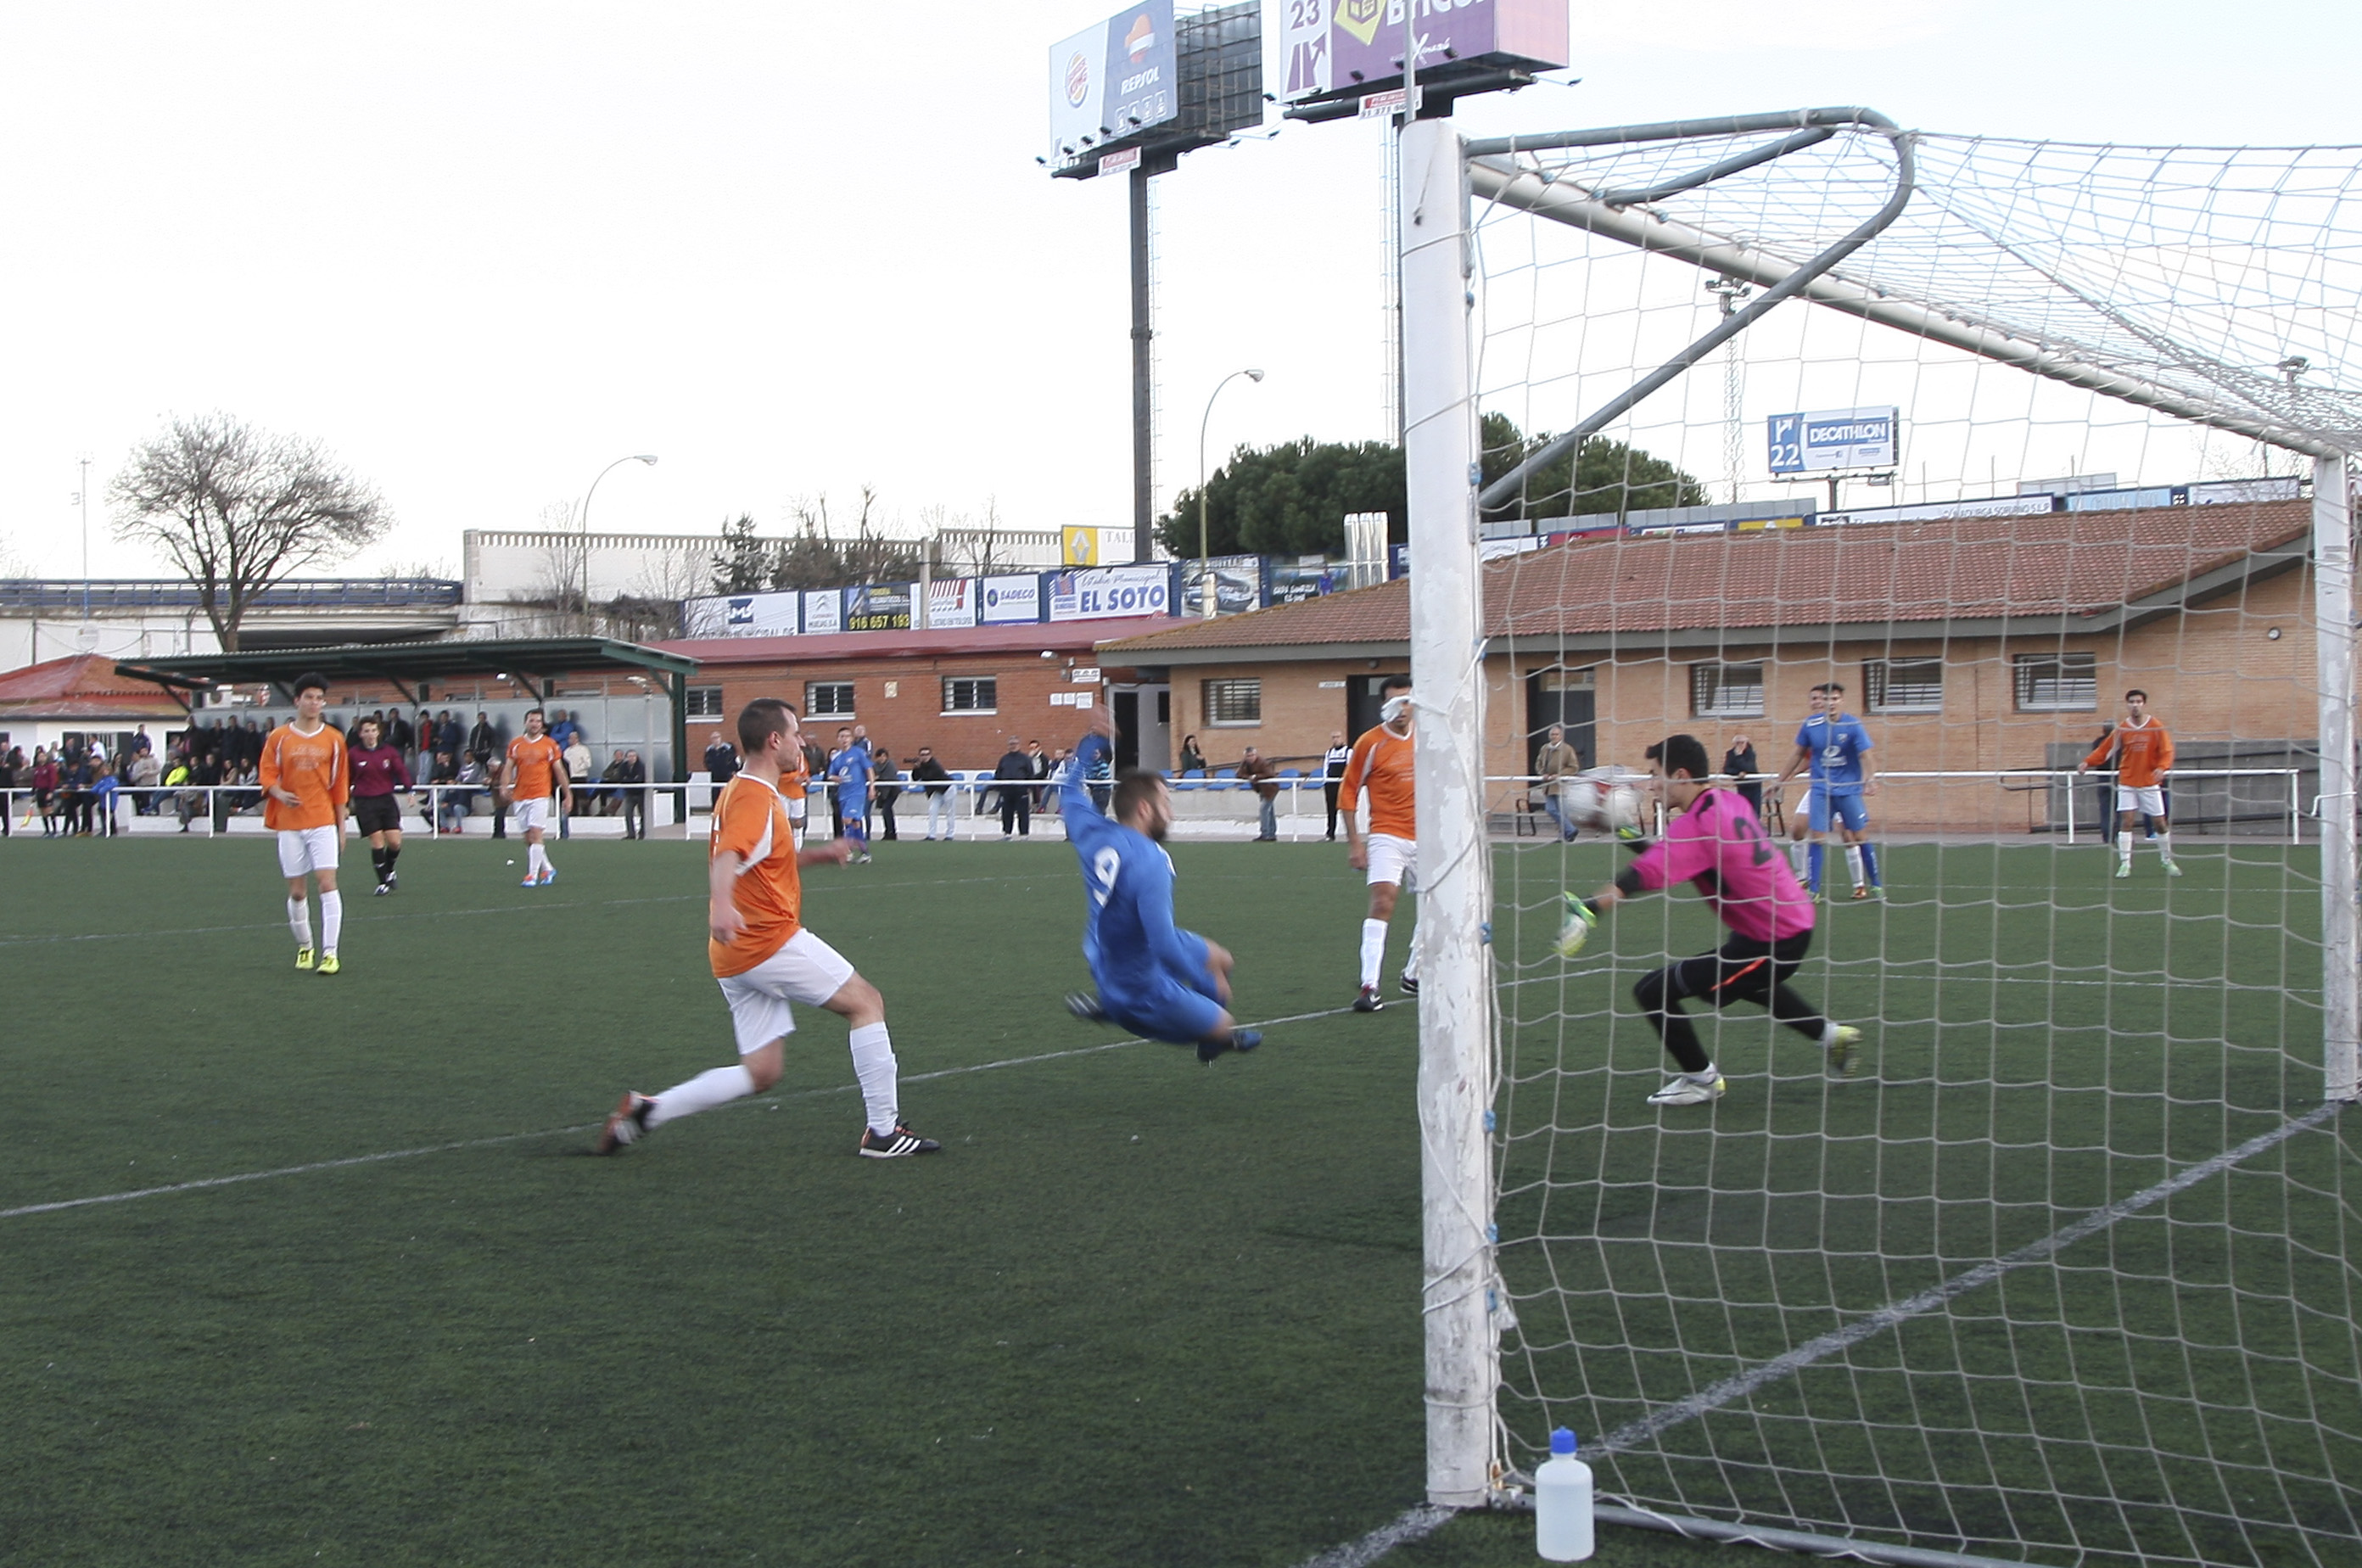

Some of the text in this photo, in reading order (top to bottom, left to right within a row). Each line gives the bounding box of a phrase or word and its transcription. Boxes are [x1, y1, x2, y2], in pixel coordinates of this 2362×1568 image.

[1290, 0, 1321, 31] 23
[1121, 65, 1161, 96] REPSOL
[1810, 423, 1886, 444] DECATHLON
[1771, 443, 1800, 468] 22
[1081, 585, 1166, 613] EL SOTO
[1094, 846, 1121, 910] 9
